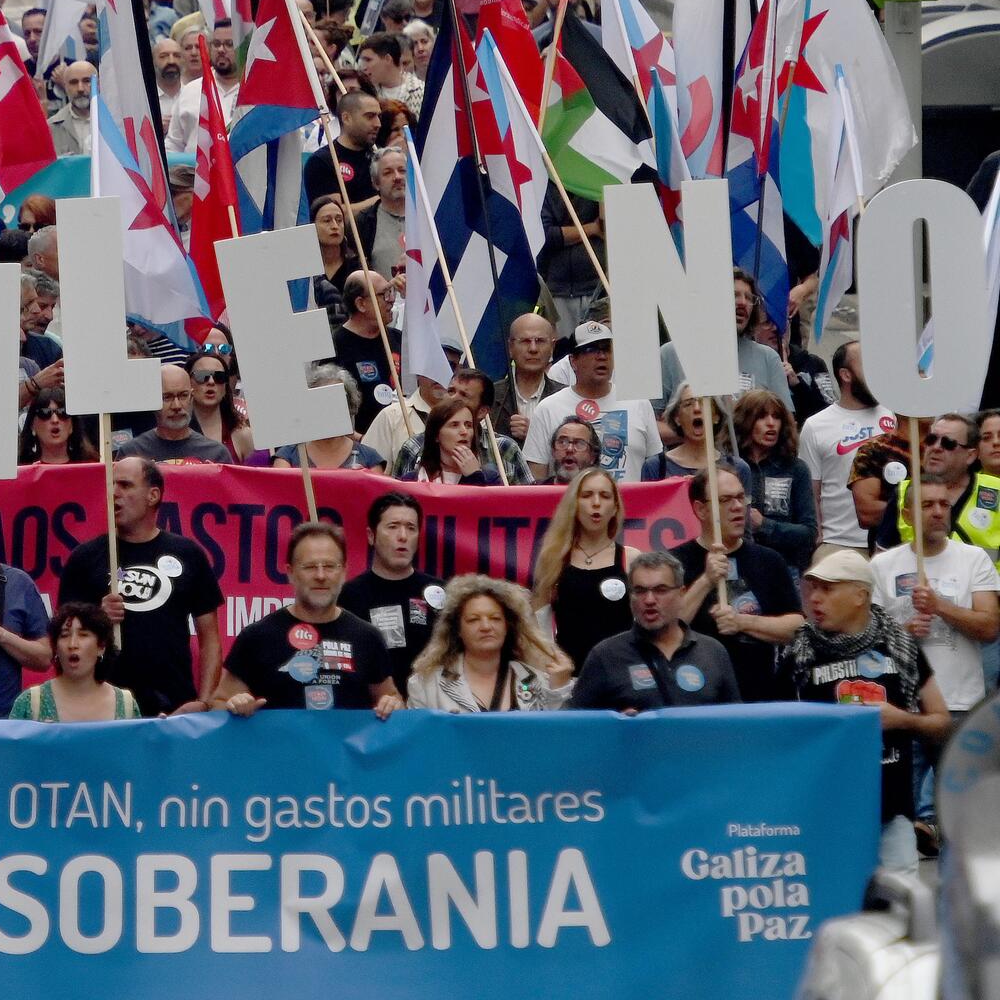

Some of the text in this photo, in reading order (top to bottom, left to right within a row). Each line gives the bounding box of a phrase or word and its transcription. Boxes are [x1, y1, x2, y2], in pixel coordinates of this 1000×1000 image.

[295, 628, 313, 641] CIG
[8, 781, 144, 833] OTAN,
[159, 783, 228, 828] nin
[244, 782, 392, 843] gastos
[405, 776, 606, 828] militares
[728, 823, 800, 838] Plataforma
[682, 846, 807, 881] Galiza
[720, 878, 810, 918] pola
[738, 912, 813, 942] Paz
